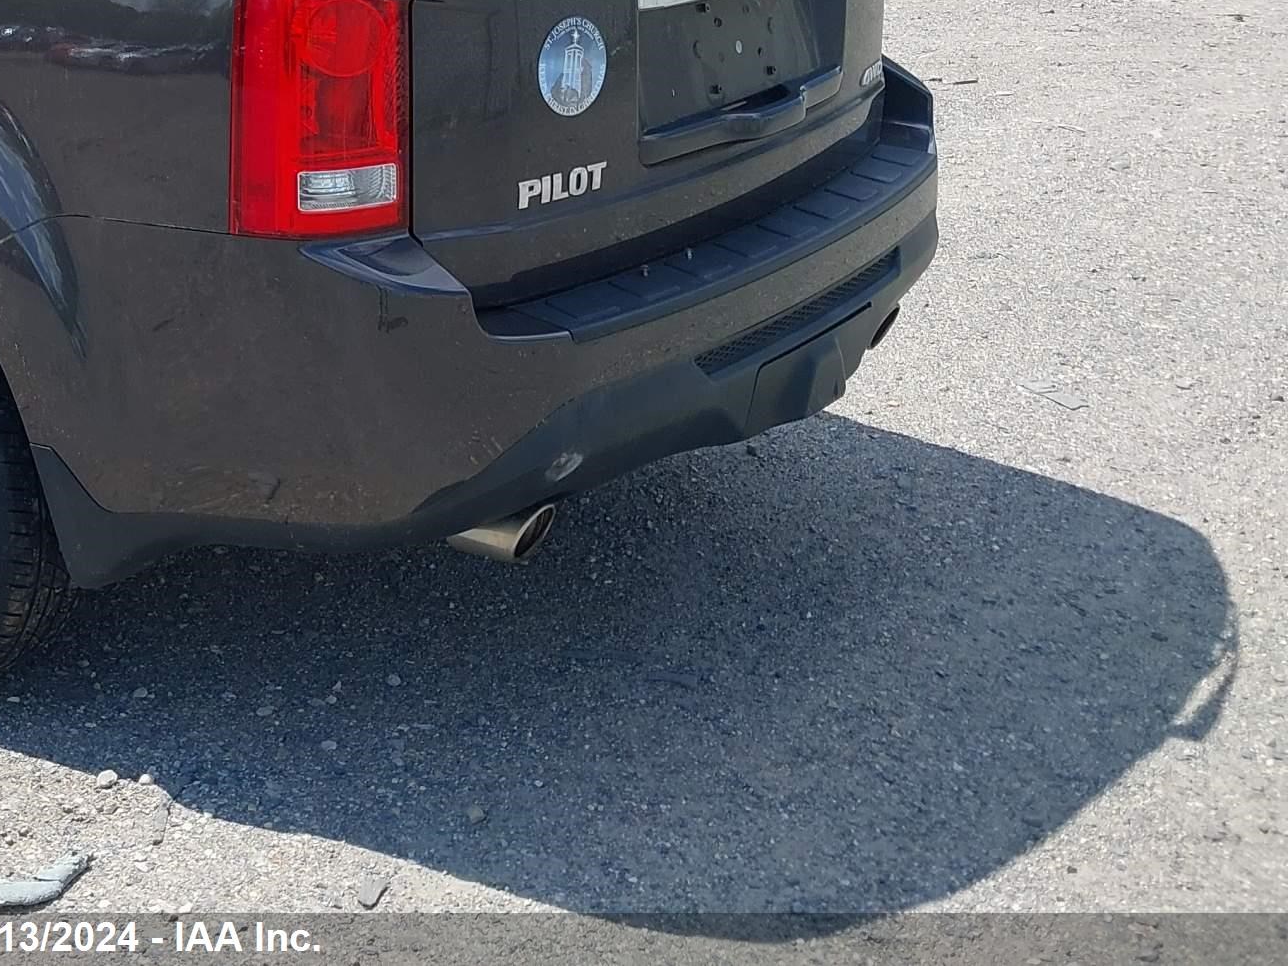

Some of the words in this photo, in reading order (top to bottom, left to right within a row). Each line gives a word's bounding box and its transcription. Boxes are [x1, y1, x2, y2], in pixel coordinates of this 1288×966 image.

[552, 17, 582, 41] JOSEPH'S
[582, 18, 605, 51] CHURCH
[518, 162, 608, 209] PILOT
